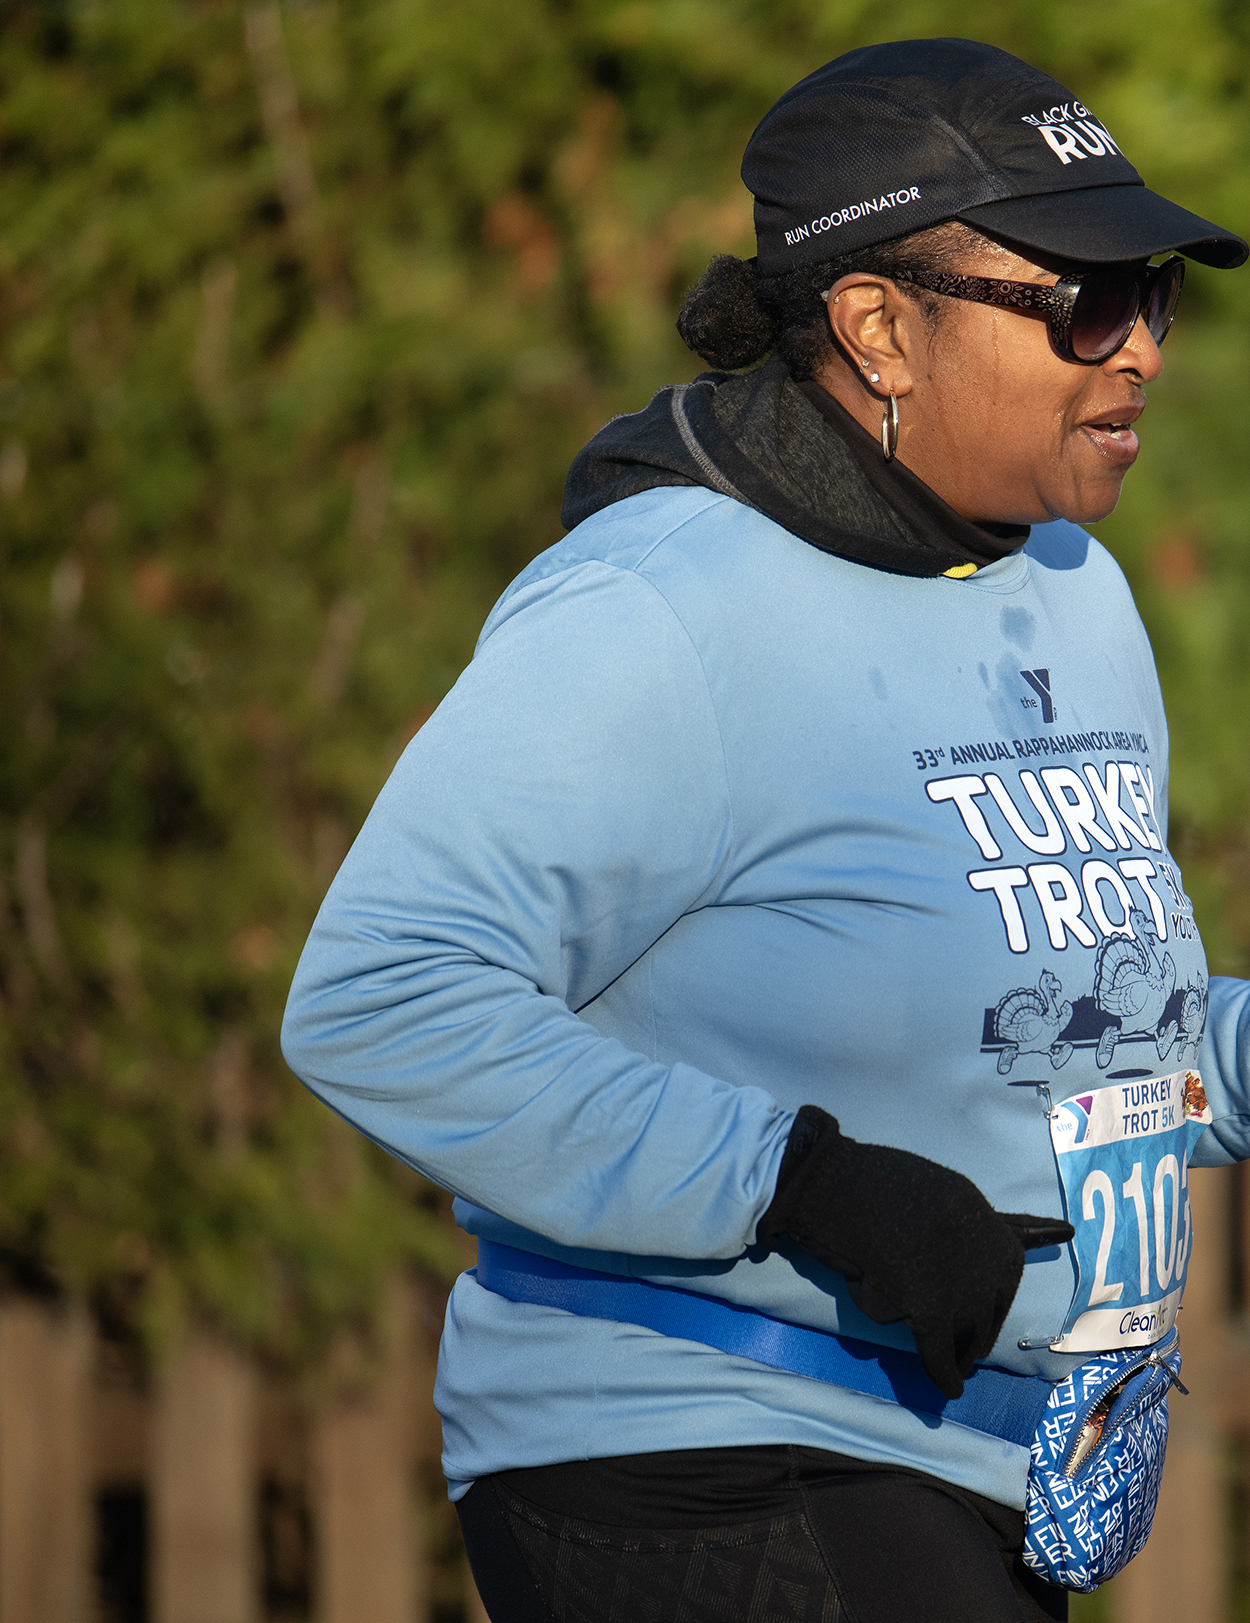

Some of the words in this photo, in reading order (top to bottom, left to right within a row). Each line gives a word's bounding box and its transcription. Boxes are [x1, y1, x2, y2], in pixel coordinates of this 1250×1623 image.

[1021, 103, 1075, 126] BLACK
[1037, 119, 1124, 165] RUN
[784, 224, 811, 246] RUN
[811, 186, 921, 234] COORDINATOR
[1020, 668, 1054, 724] Y
[1020, 696, 1038, 709] the
[912, 746, 945, 770] 33rd
[950, 741, 1015, 765] ANNUAL
[1012, 731, 1115, 758] RAPPAHANNOCK
[1110, 731, 1134, 751] AREA
[1129, 732, 1150, 754] YMCA
[925, 760, 1167, 861] TURKEY
[966, 857, 1168, 954] TROT
[1122, 1078, 1172, 1108] TURKEY
[1056, 1122, 1073, 1133] the
[1060, 1095, 1093, 1144] Y
[1122, 1109, 1158, 1135] TROT
[1161, 1104, 1175, 1128] 5K
[1034, 1522, 1066, 1549] FIN
[1045, 1542, 1077, 1566] ER
